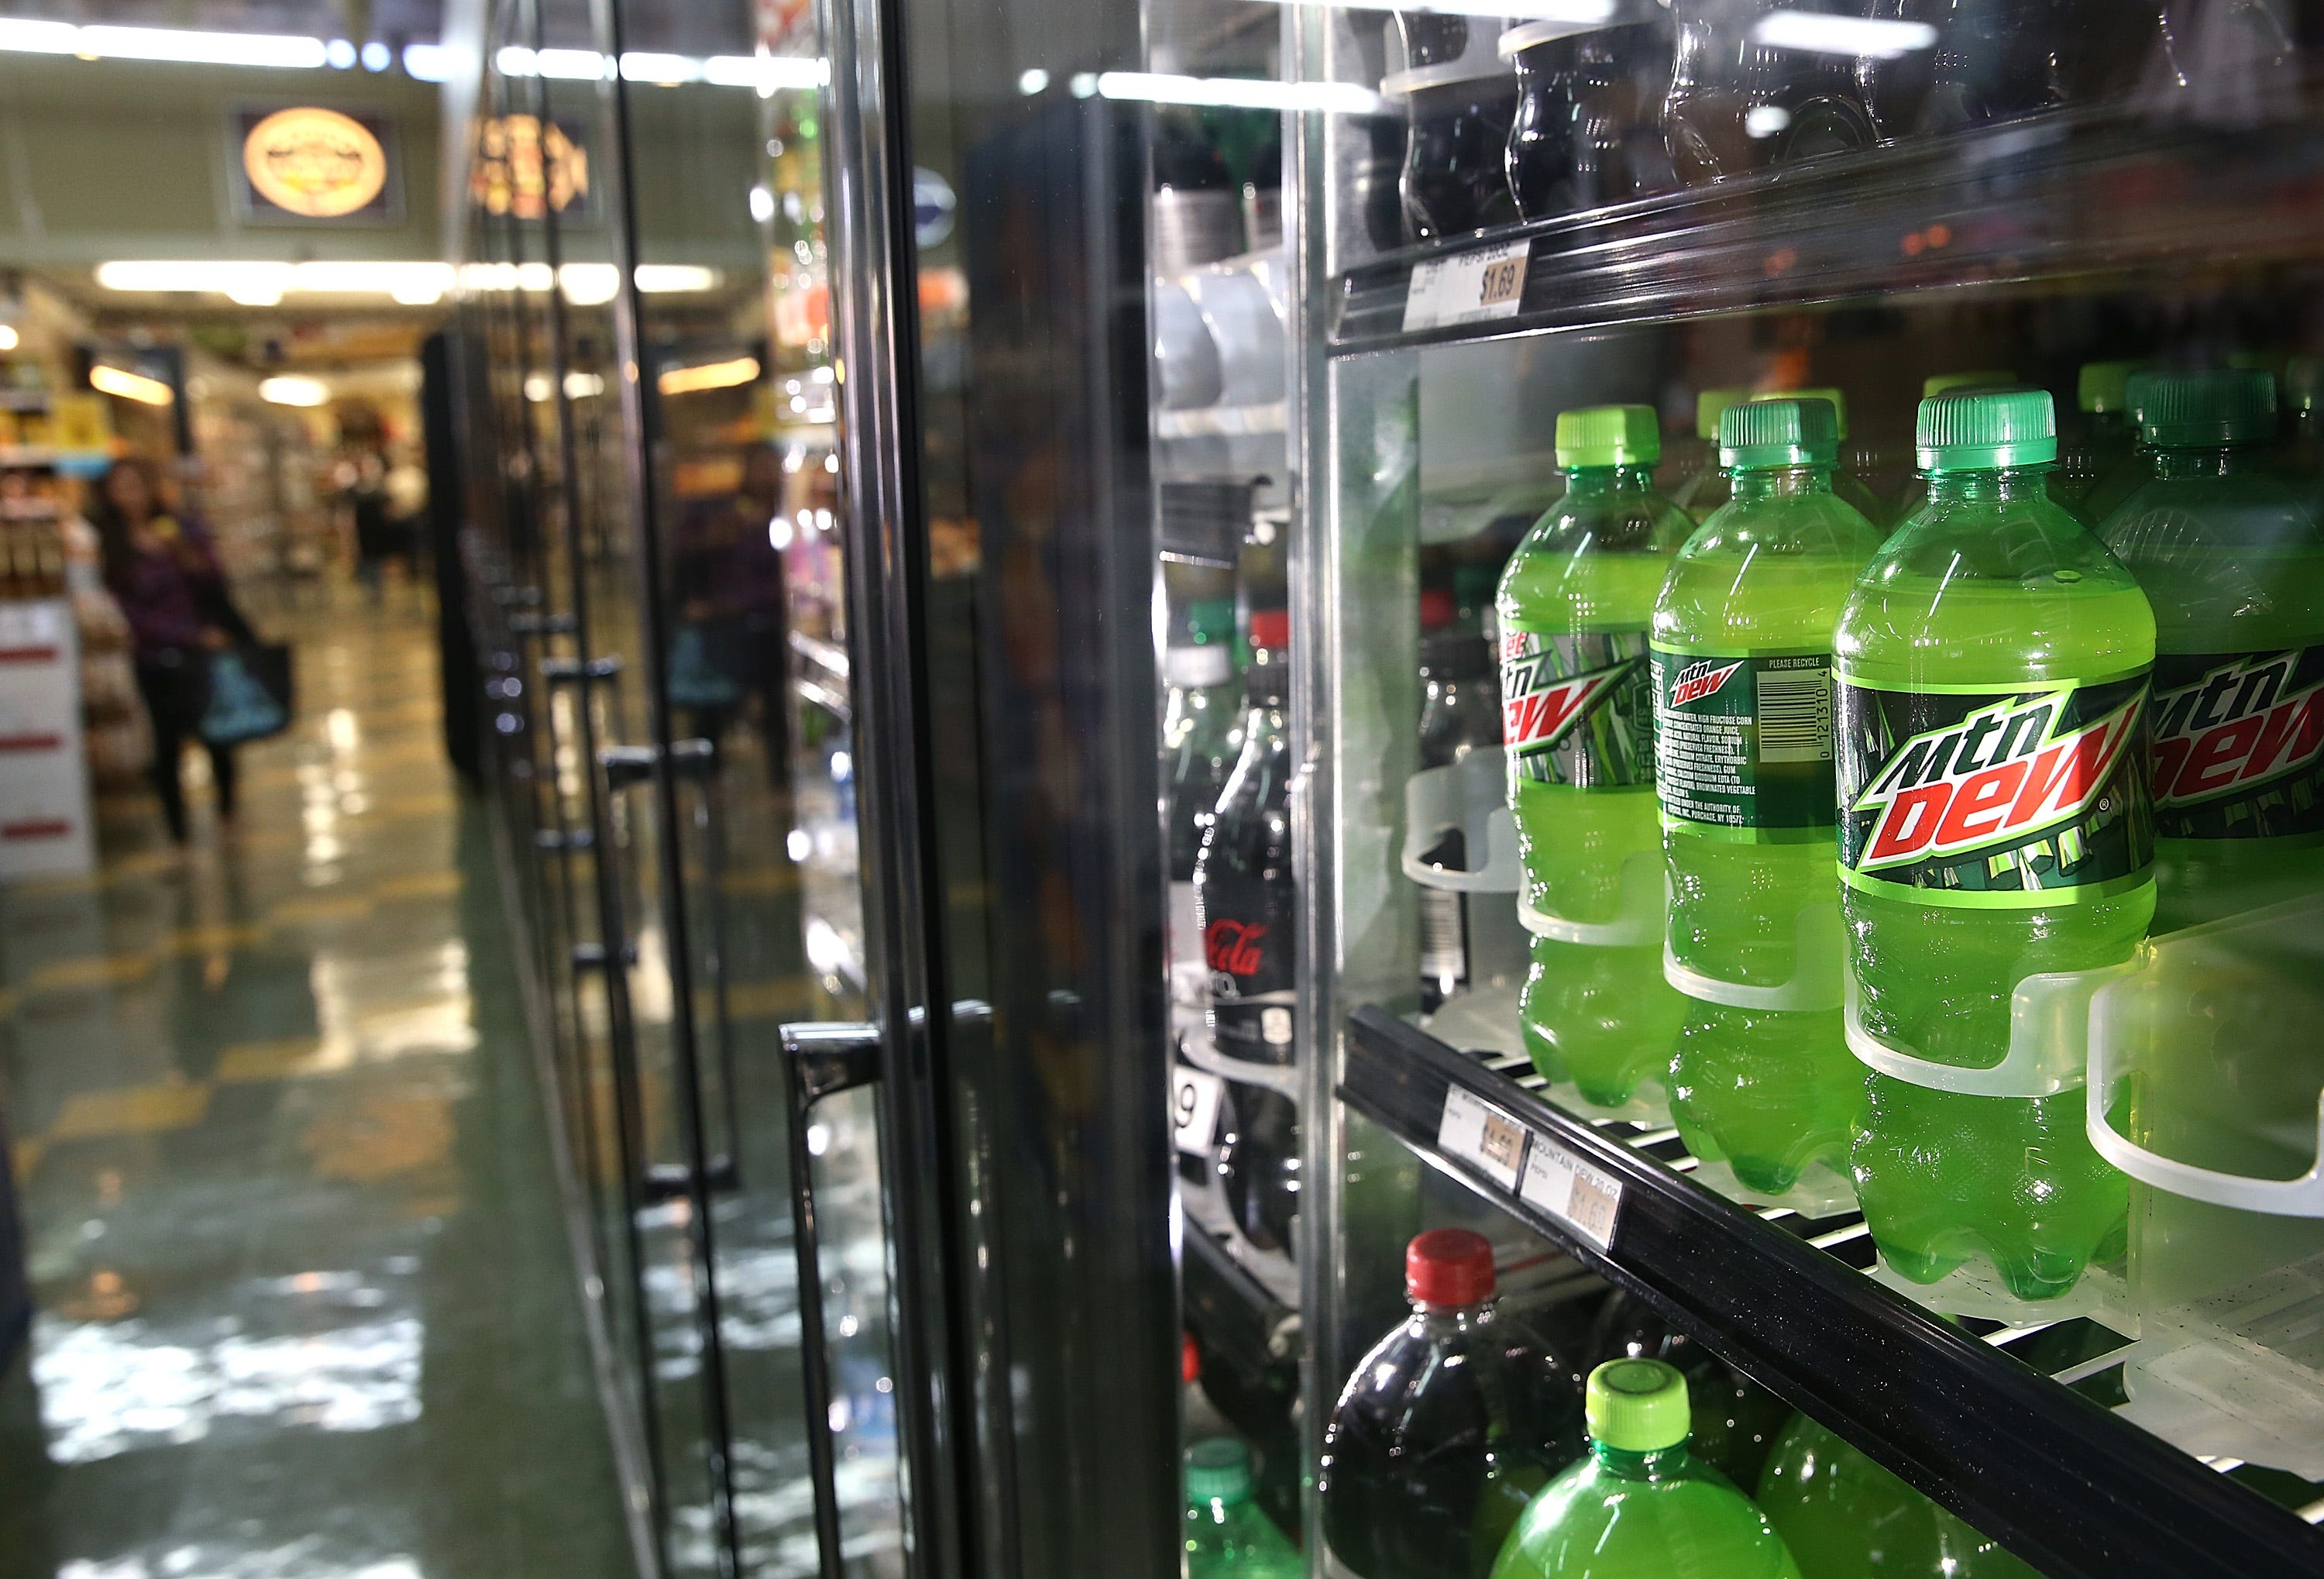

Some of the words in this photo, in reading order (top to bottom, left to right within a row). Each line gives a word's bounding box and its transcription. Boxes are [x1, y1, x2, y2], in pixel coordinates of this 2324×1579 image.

[1480, 264, 1514, 301] $1.69
[1769, 659, 1791, 669] PLEASE
[1793, 658, 1820, 668] RECYCLE
[1676, 662, 1708, 686] Mtn
[1674, 667, 1734, 705] Dew
[1710, 715, 1735, 725] FRUCTOSE
[1736, 716, 1752, 725] CORN
[1703, 724, 1722, 734] ORANGE
[1721, 736, 1742, 745] SODIUM
[1872, 703, 2053, 796] Mtn
[1714, 755, 1747, 765] ERYTHORBIC
[1723, 765, 1736, 774] GUM
[1717, 776, 1730, 784] EDTA
[1731, 776, 1741, 785] (TO
[1869, 699, 2141, 860] Dew
[1727, 786, 1755, 795] VEGETABLE
[1695, 801, 1703, 810] THE
[1703, 803, 1731, 813] AUTHORITY
[1717, 814, 1725, 822] NY
